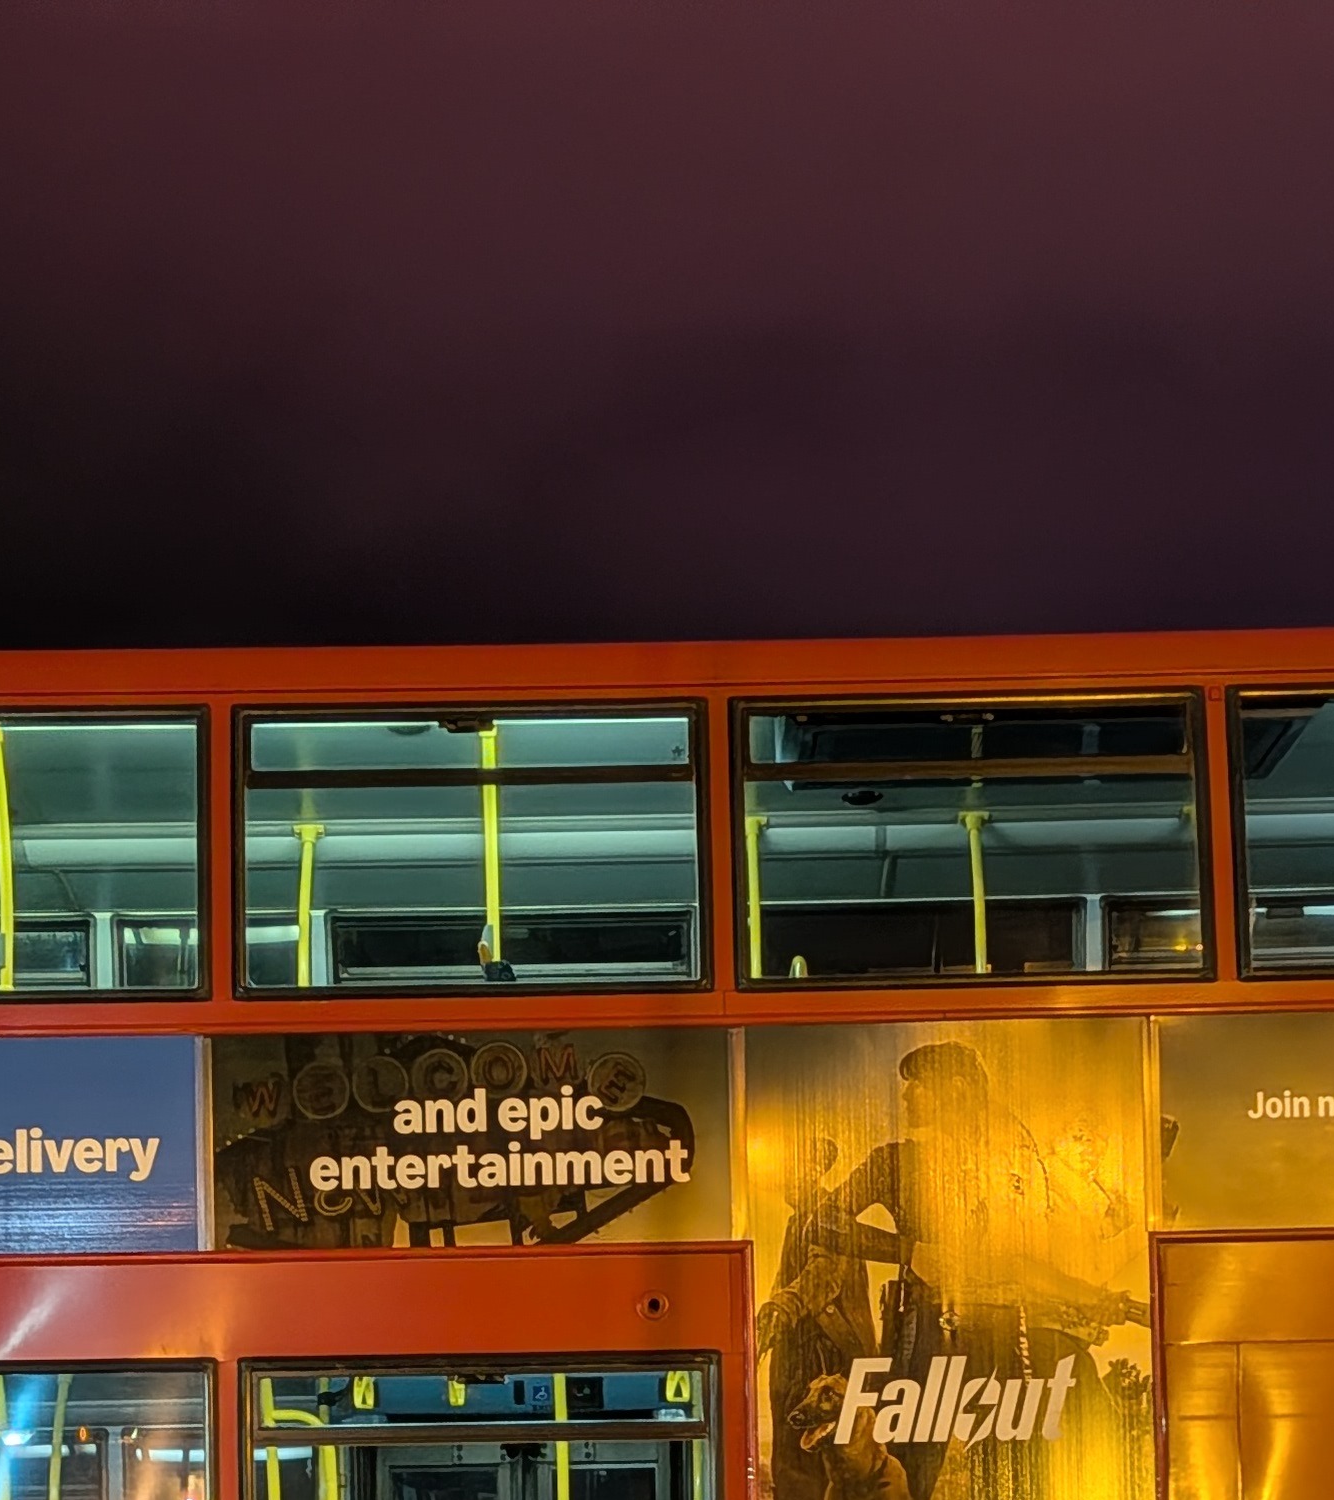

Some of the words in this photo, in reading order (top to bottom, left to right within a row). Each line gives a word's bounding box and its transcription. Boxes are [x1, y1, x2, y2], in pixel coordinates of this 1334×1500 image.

[393, 1087, 486, 1135] and
[497, 1085, 605, 1140] epic
[1248, 1090, 1311, 1119] Join
[309, 1140, 691, 1191] entertainment
[833, 1354, 1077, 1453] Fallout
